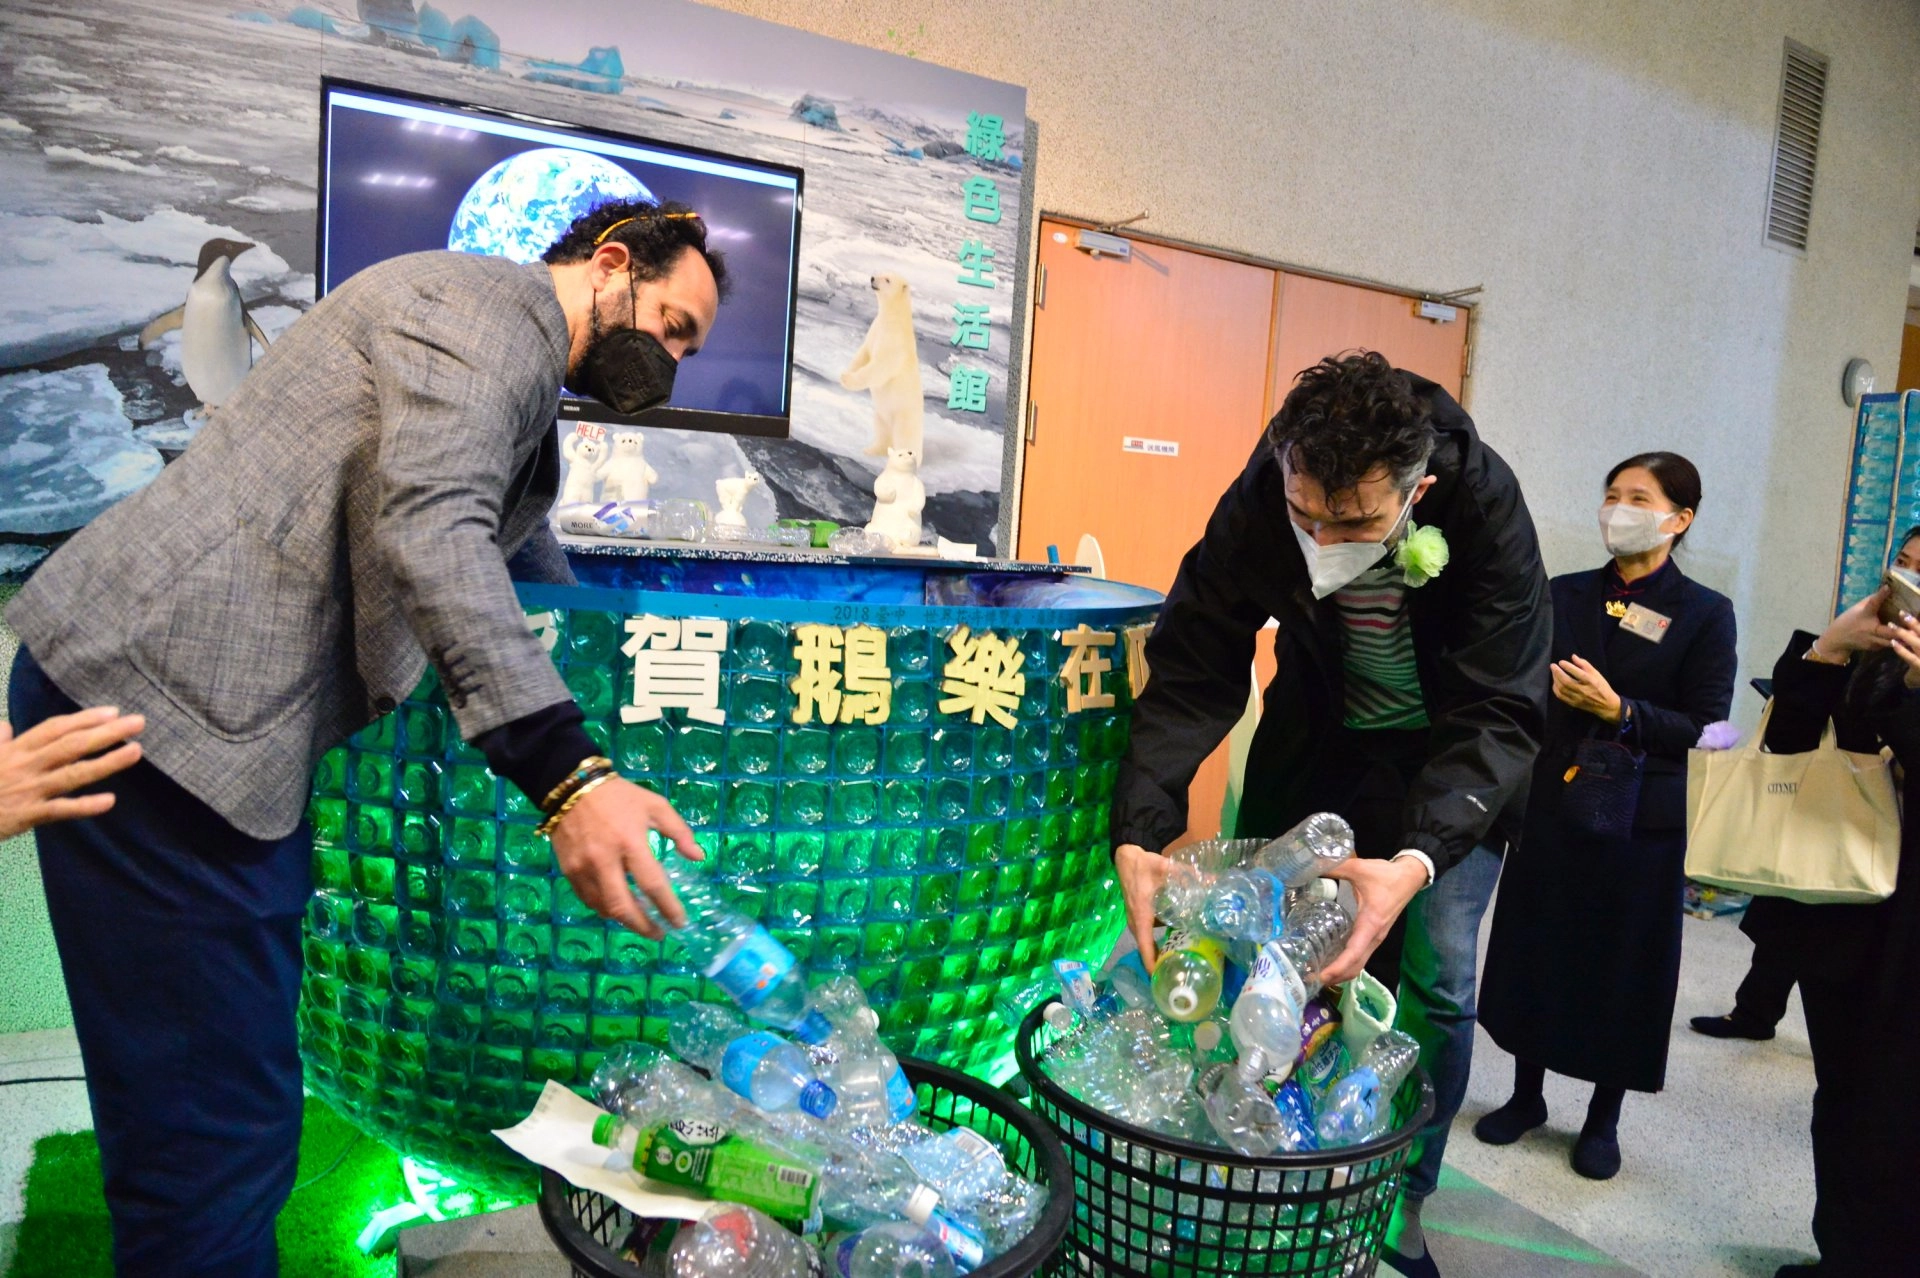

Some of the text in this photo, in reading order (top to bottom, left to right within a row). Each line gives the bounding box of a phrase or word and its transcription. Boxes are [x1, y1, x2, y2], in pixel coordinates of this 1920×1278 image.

[947, 110, 1006, 413] 綠色生活館
[576, 423, 606, 440] HELP
[571, 520, 593, 529] MORE
[523, 611, 1151, 730] 賀鵝樂在
